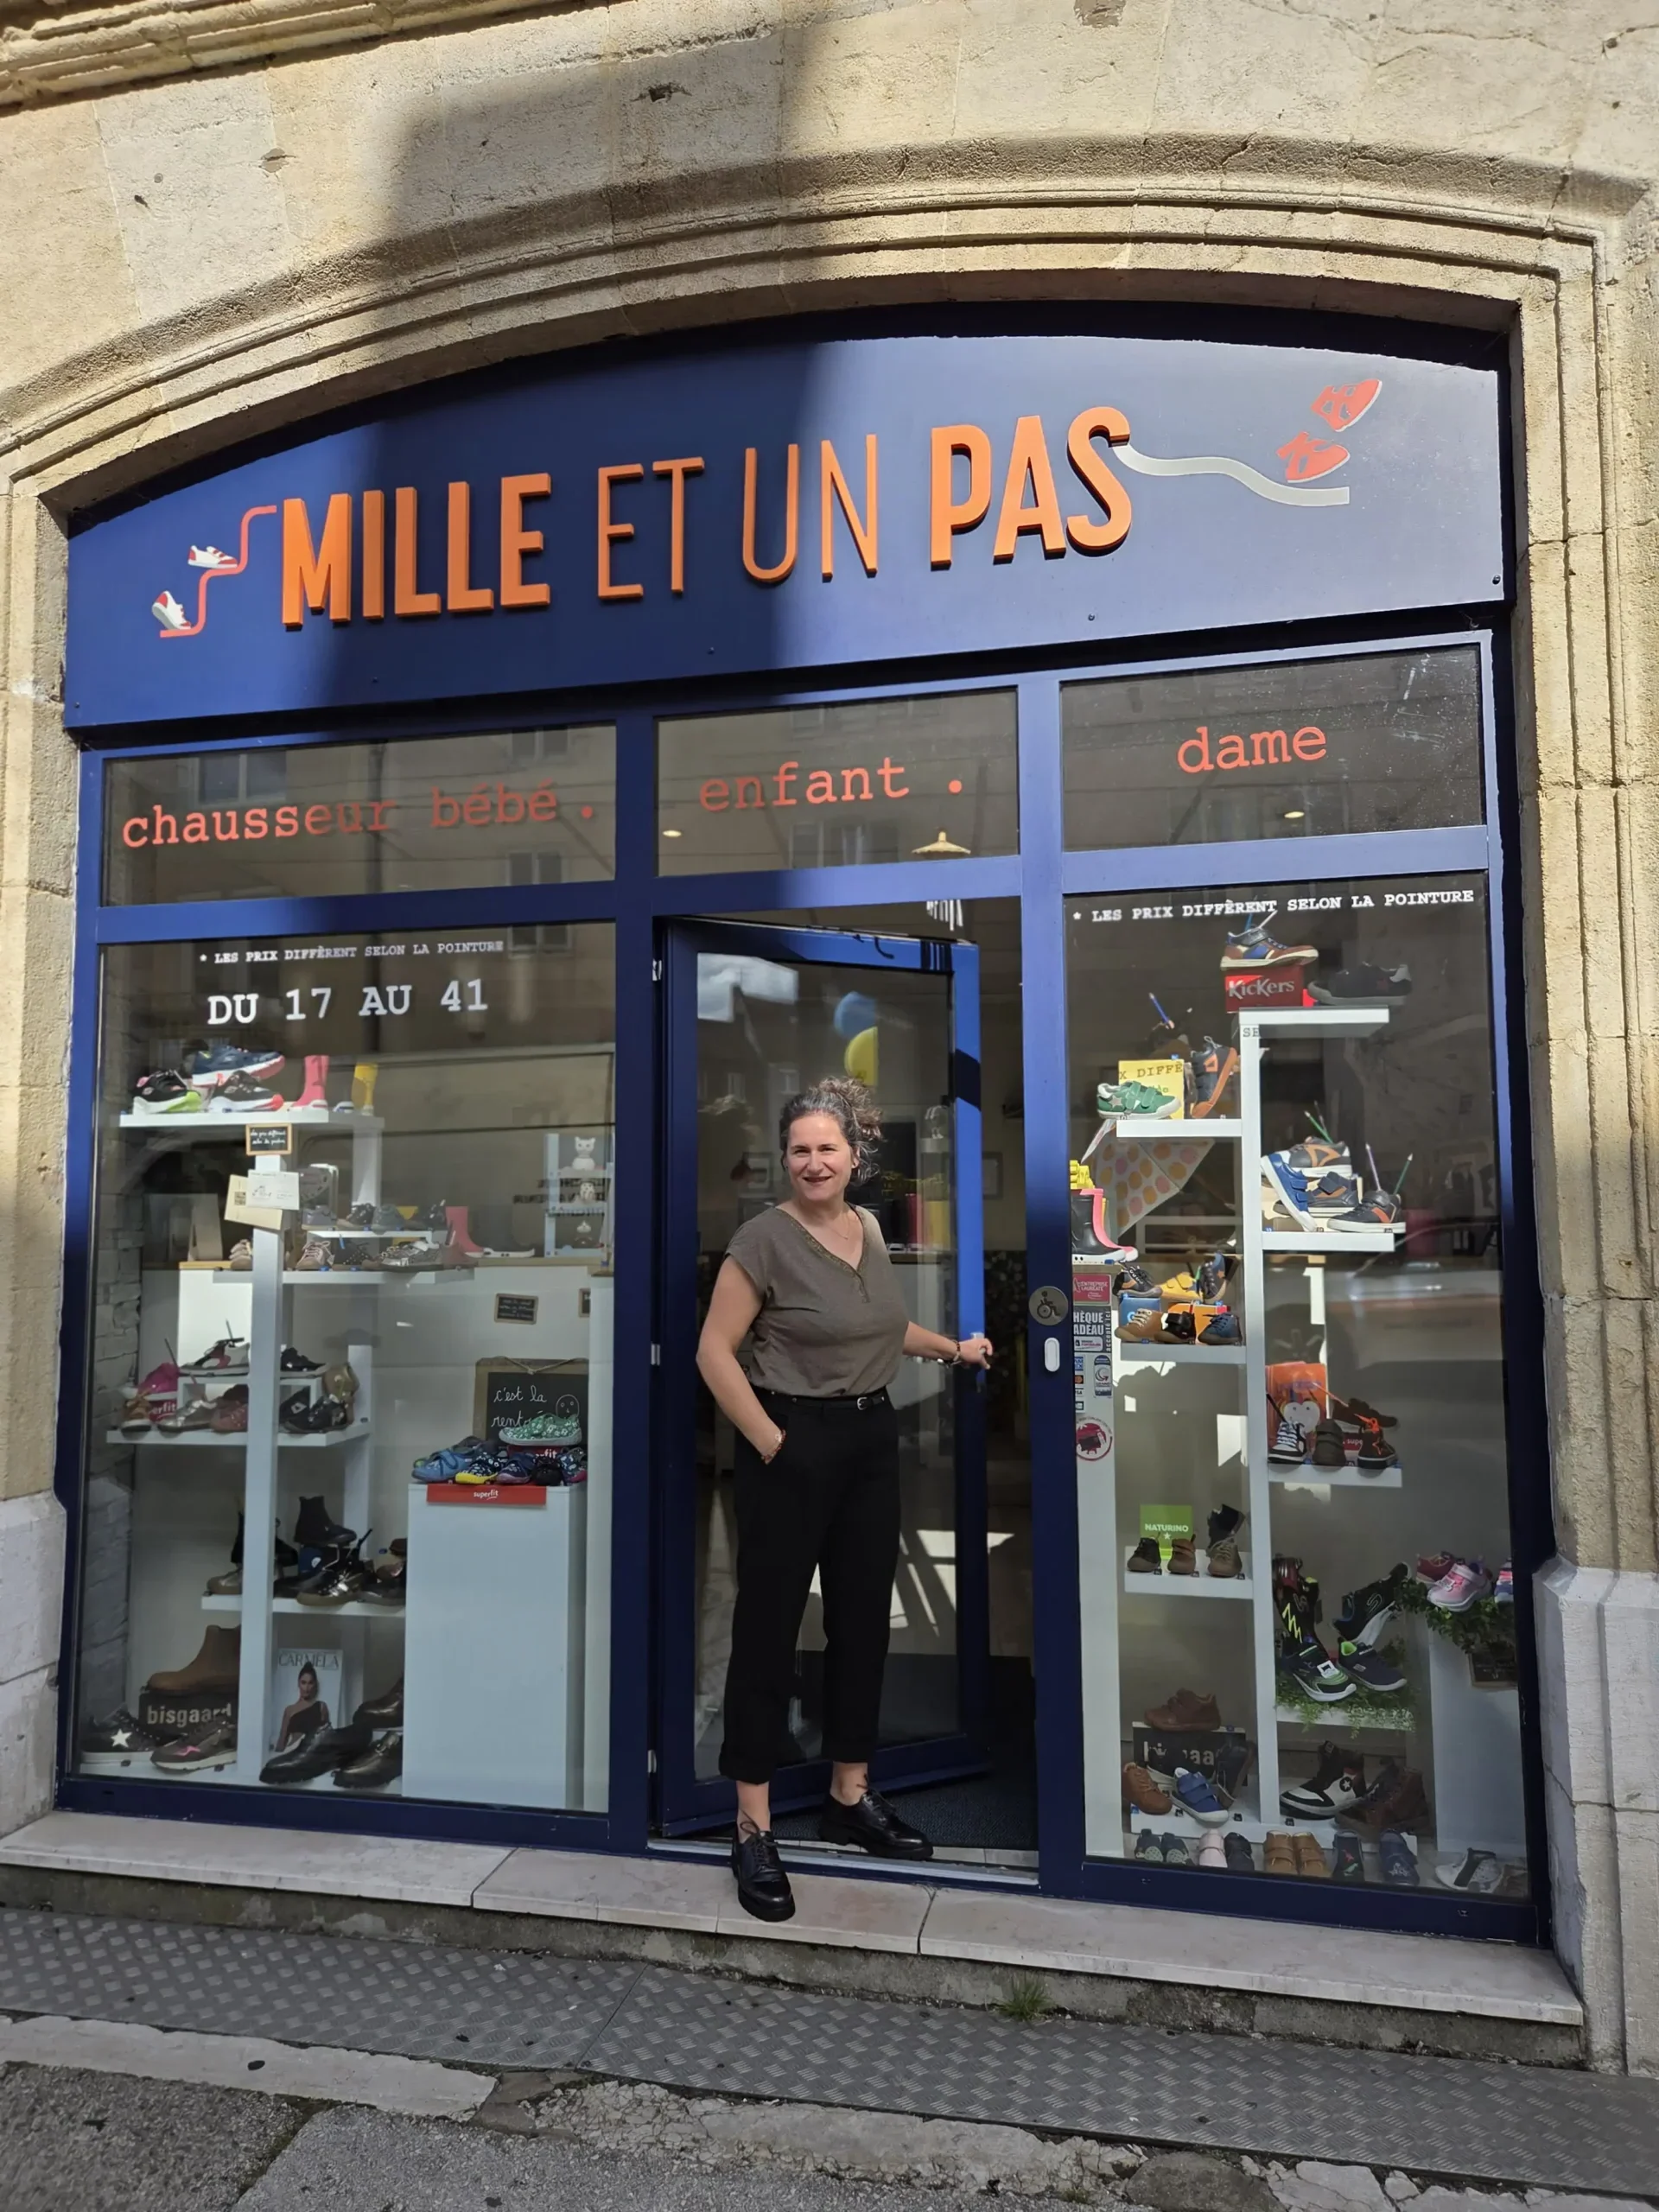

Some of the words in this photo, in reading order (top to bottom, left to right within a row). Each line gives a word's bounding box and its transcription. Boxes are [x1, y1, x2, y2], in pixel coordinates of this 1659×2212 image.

[283, 474, 551, 626] MILLE
[598, 458, 704, 601] ET
[742, 434, 878, 582] UN
[930, 406, 1132, 567] PAS
[1176, 725, 1327, 774] dame
[699, 757, 910, 812] enfant
[121, 800, 396, 849] chausseur
[431, 779, 557, 828] bébé
[1091, 908, 1122, 923] LES
[1131, 906, 1174, 920] PRIX
[1287, 896, 1343, 912] SELON
[1351, 894, 1376, 908] LA
[1383, 889, 1475, 906] POINTURE
[213, 951, 239, 964] LES
[245, 950, 278, 963] PRIX
[364, 944, 405, 957] SELON
[412, 944, 429, 955] LA
[436, 940, 504, 954] POINTURE
[207, 993, 260, 1025] DU
[285, 987, 332, 1020] 17
[358, 984, 412, 1016] AU
[440, 978, 488, 1012] 41
[1073, 1310, 1104, 1324] HÈQUE
[1073, 1324, 1104, 1336] ADEAU
[493, 1385, 524, 1403] c'est
[530, 1384, 547, 1403] la
[1144, 1523, 1189, 1533] NATURINO
